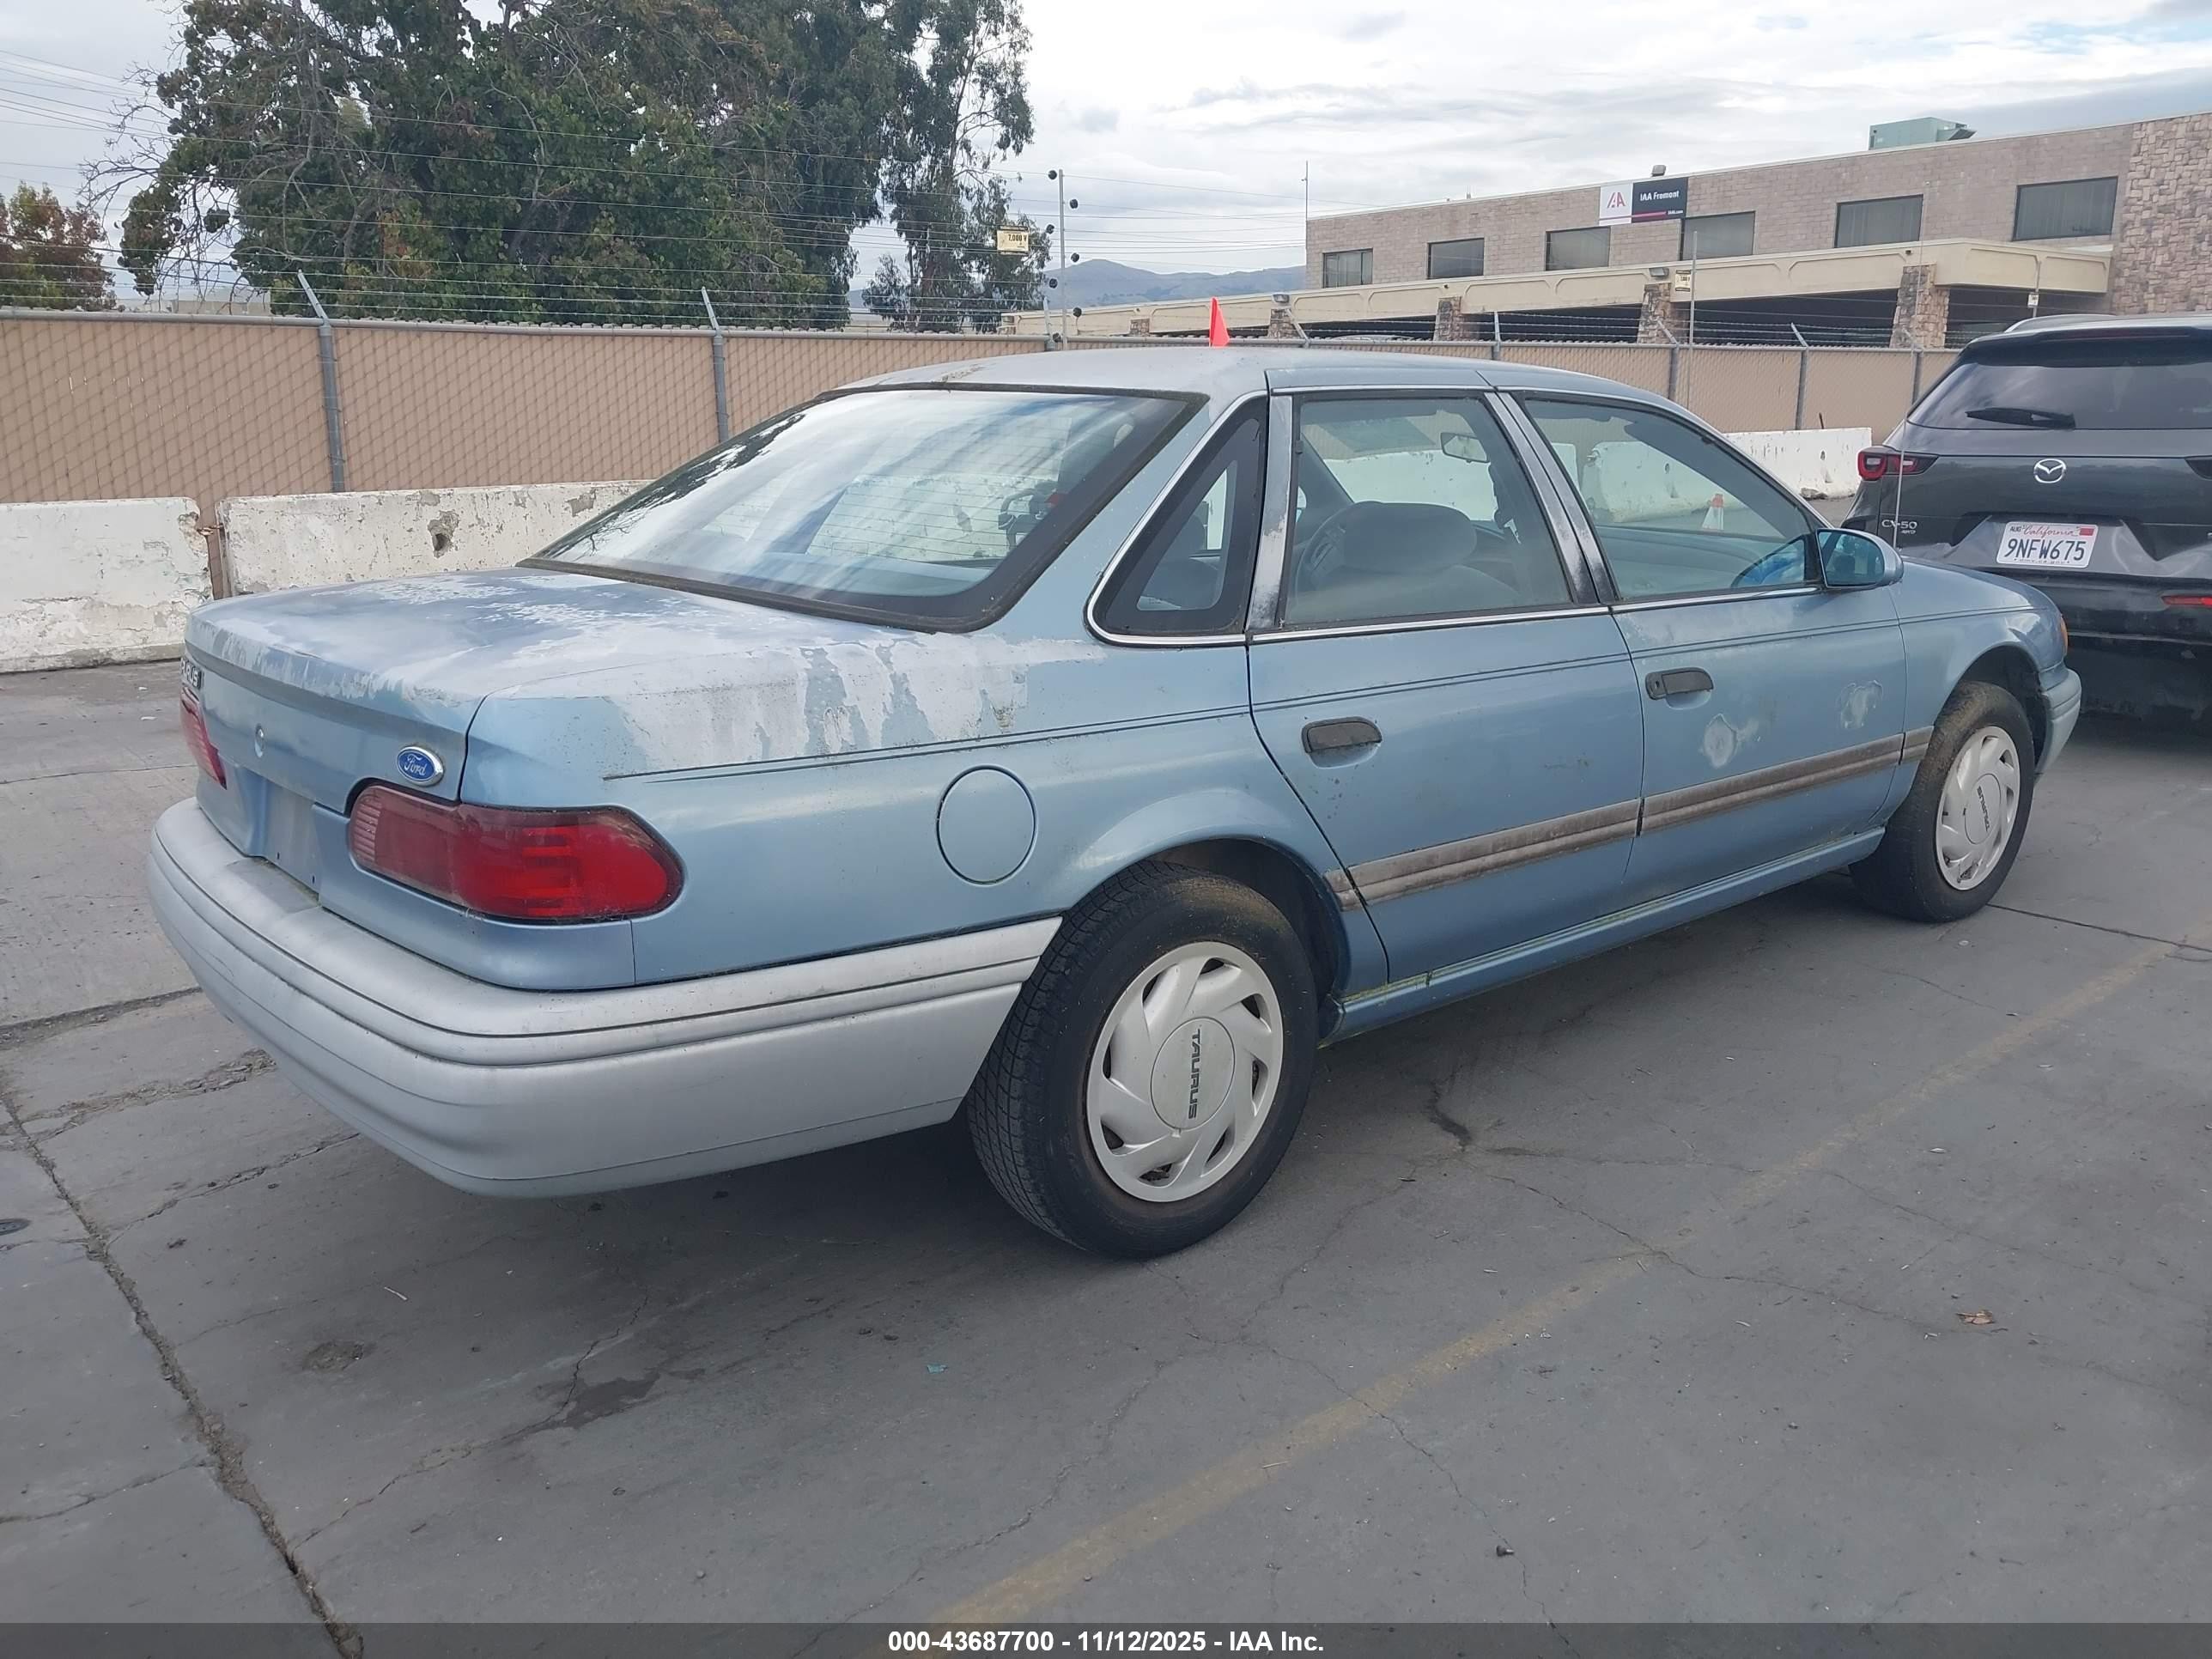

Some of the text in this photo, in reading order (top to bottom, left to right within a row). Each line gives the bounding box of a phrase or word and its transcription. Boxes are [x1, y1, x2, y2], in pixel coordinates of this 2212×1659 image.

[1640, 191, 1680, 201] IAA Fremont
[2023, 525, 2075, 539] California
[2004, 538, 2087, 561] 9NFW675
[404, 753, 428, 776] Ford
[1188, 1028, 1201, 1120] TAURUS
